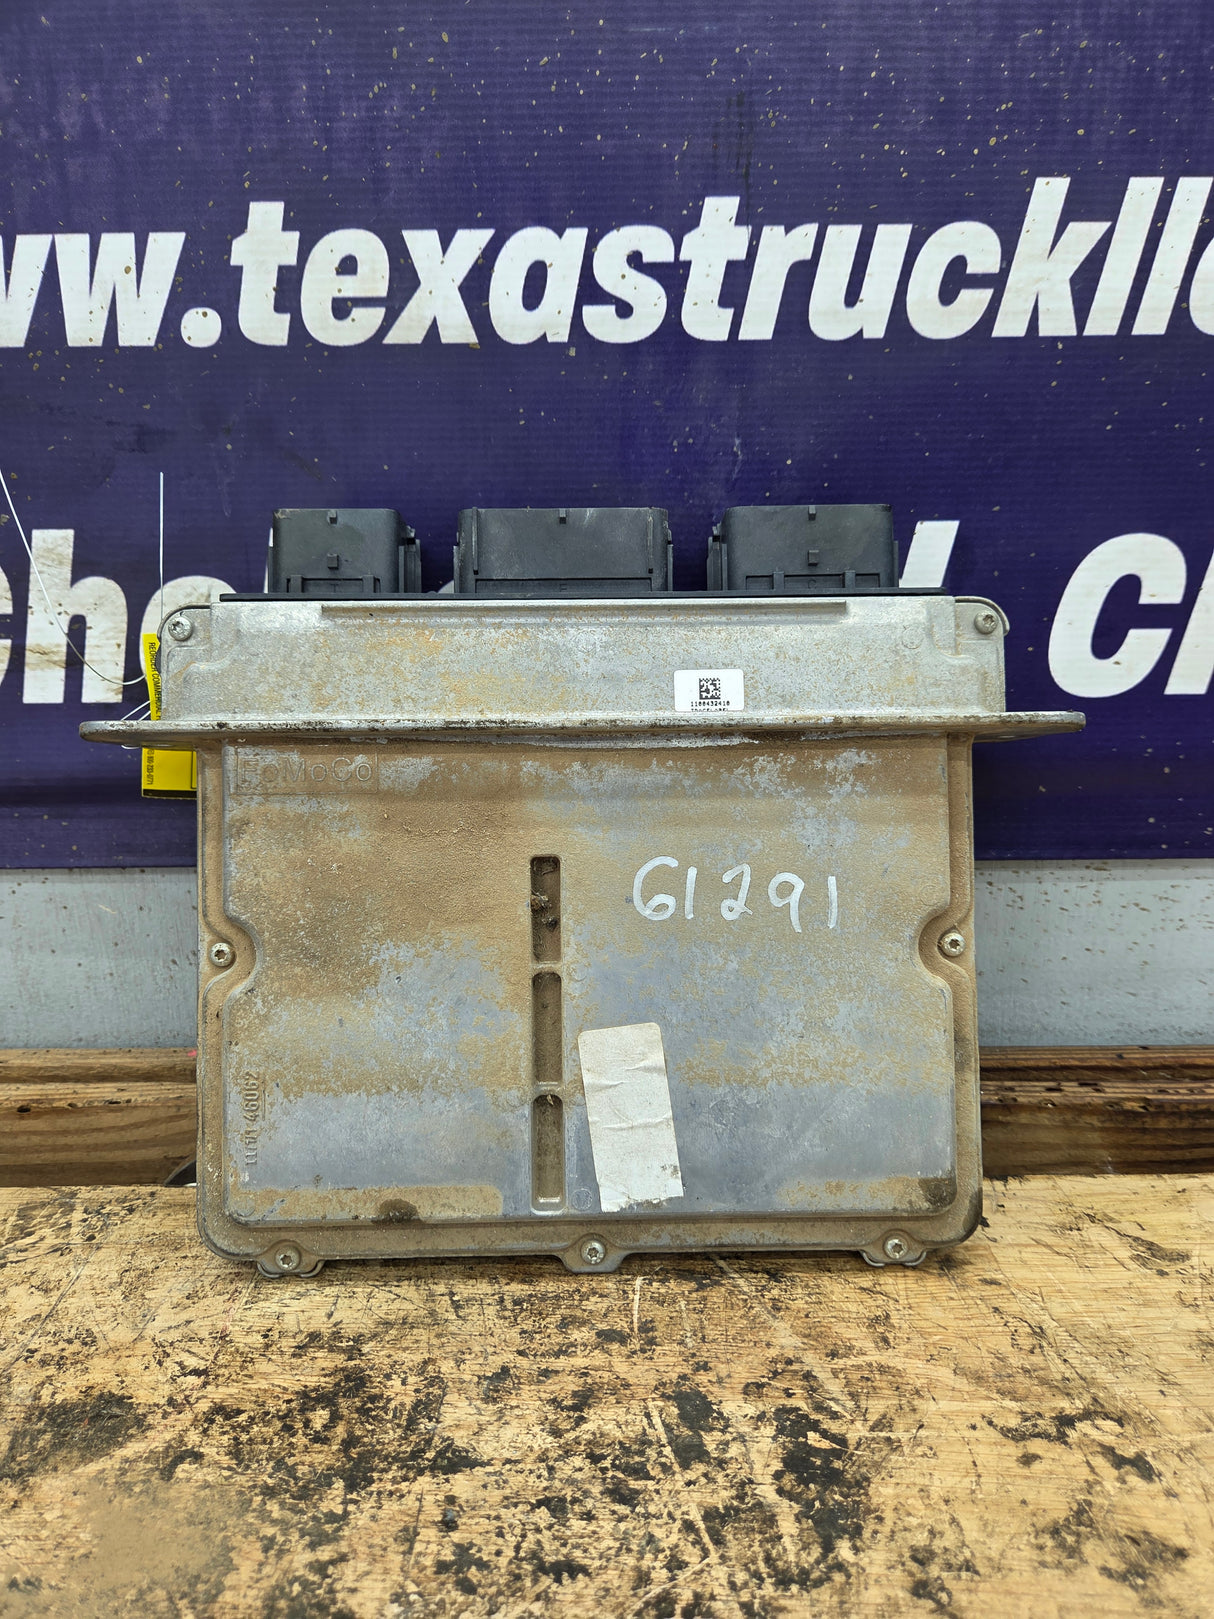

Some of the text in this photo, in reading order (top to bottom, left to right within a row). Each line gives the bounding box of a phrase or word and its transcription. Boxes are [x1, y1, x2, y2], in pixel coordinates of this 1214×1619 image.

[0, 176, 1214, 348] w.texastruckll
[241, 757, 372, 782] FoMoCo
[633, 856, 838, 933] 61291
